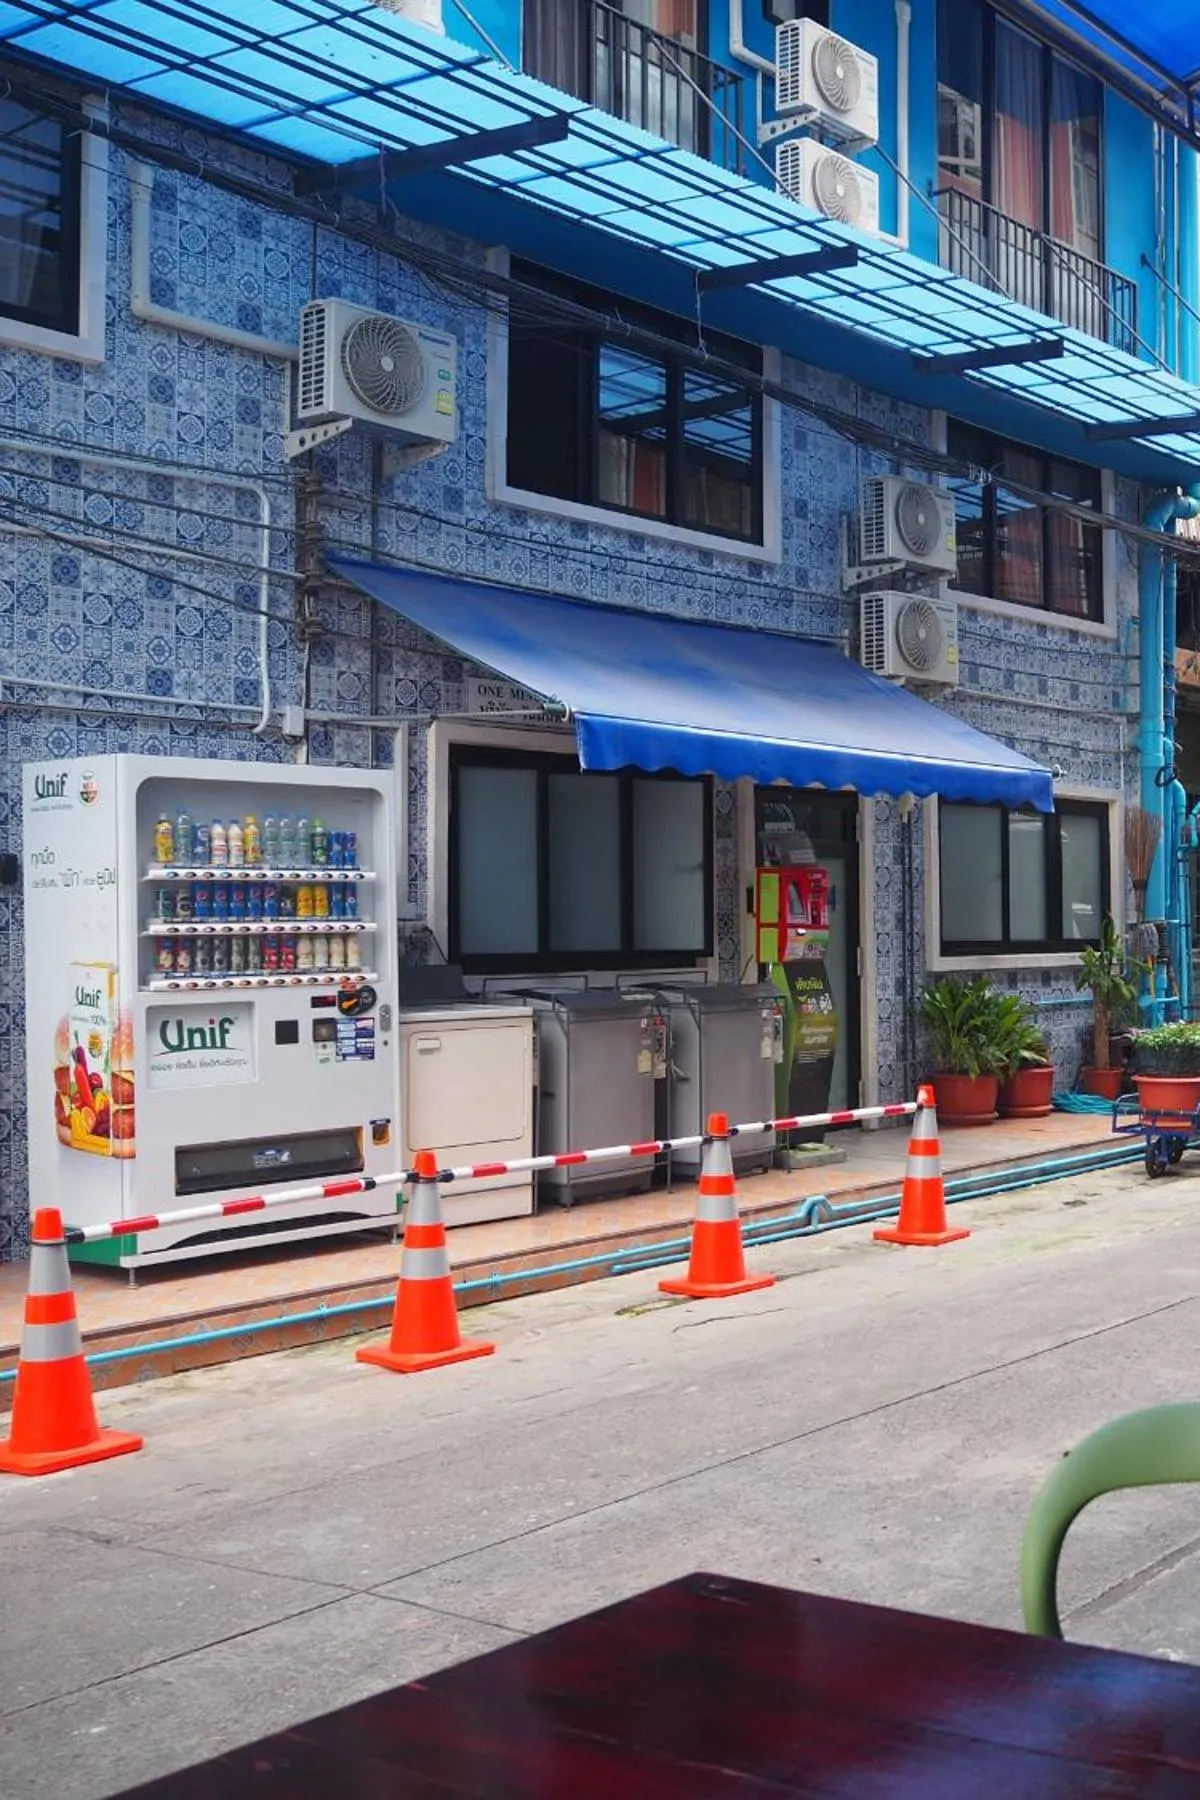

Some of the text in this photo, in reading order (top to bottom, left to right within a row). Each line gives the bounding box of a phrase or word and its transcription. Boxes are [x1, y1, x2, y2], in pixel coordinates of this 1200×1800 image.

[477, 684, 504, 698] ONE
[34, 772, 69, 799] Unif
[75, 985, 103, 1009] Unif
[159, 1017, 235, 1052] Unif
